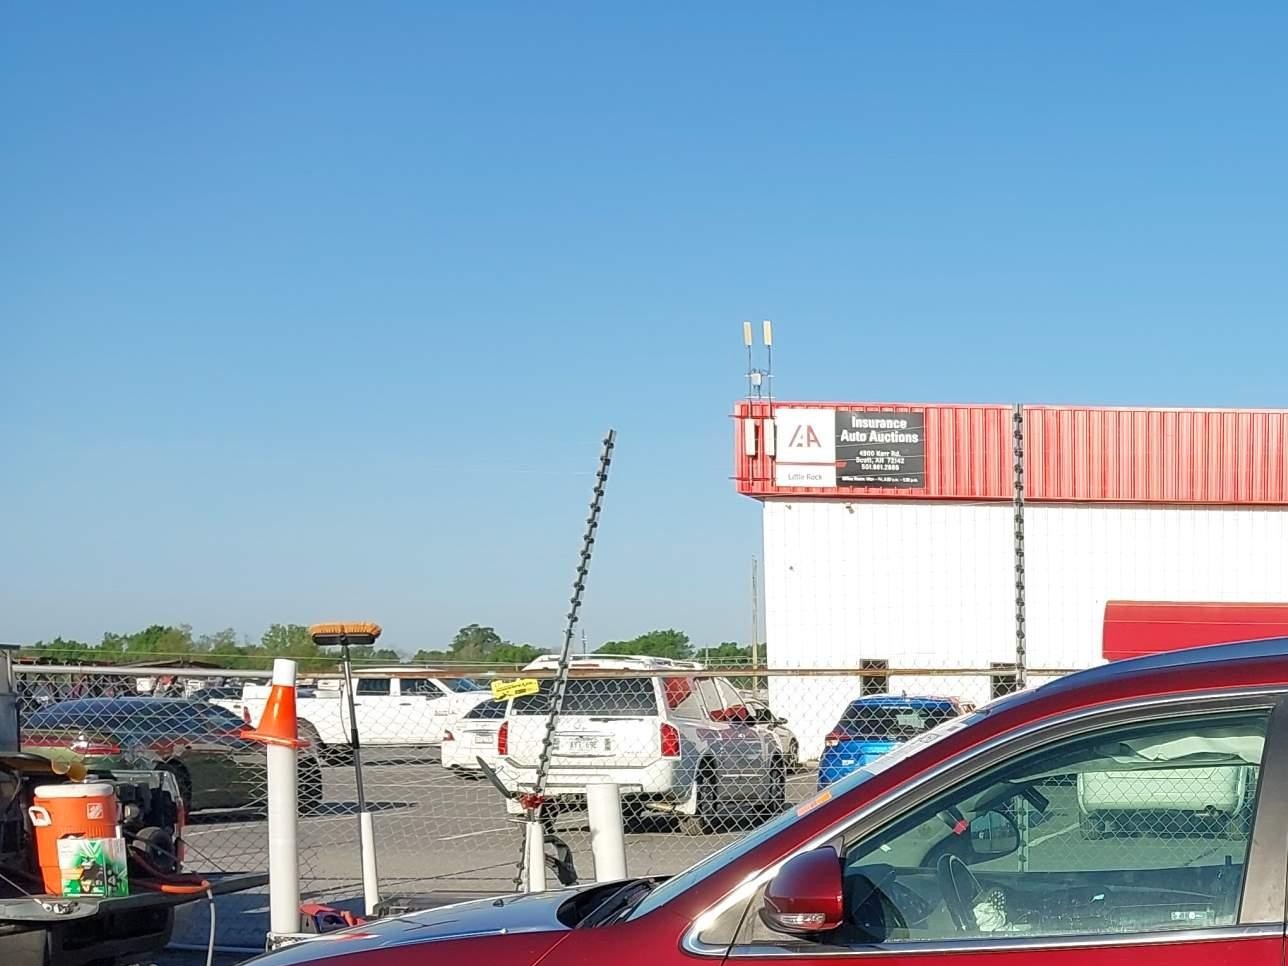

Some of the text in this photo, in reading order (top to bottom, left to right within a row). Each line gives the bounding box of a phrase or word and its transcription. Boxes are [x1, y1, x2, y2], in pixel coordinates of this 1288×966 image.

[852, 415, 907, 429] Insurance
[840, 429, 919, 444] Auto Auctions
[788, 473, 823, 481] Little Rock
